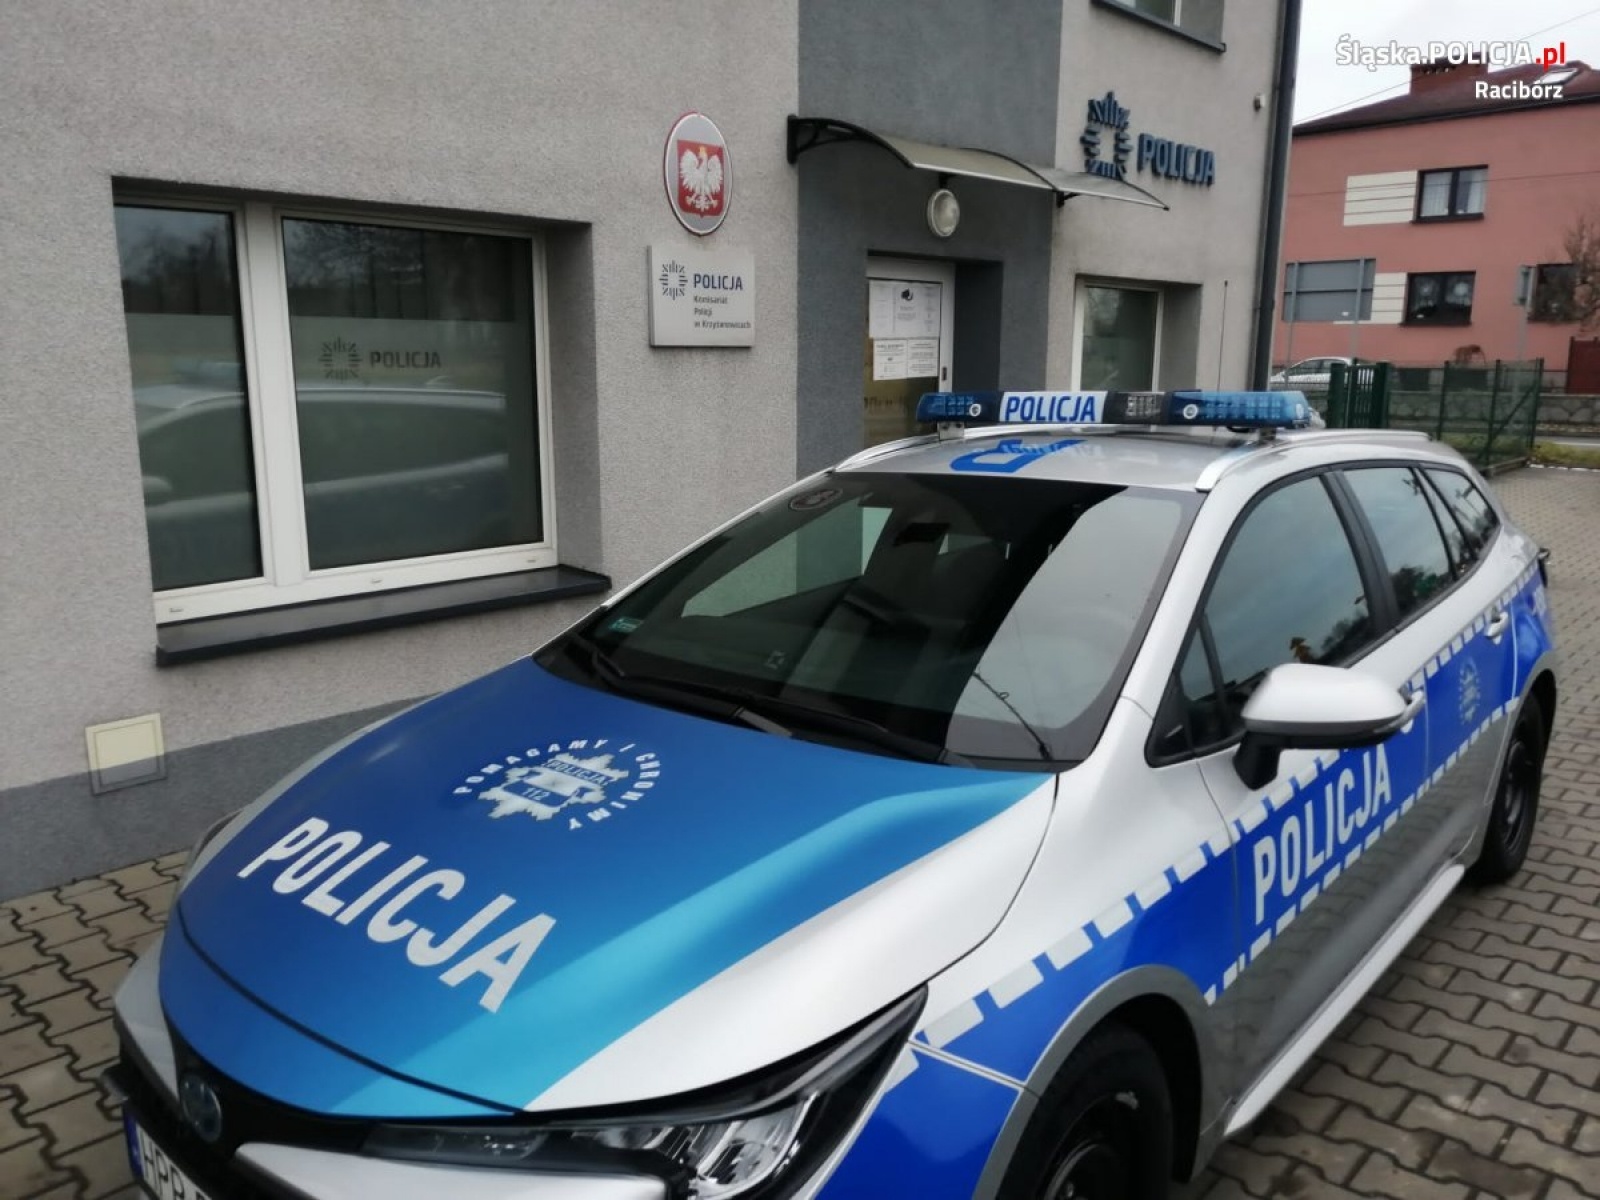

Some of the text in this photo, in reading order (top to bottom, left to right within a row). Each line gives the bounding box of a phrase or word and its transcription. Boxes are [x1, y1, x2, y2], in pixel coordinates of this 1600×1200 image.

[1137, 133, 1215, 186] POLICJA
[693, 274, 743, 290] POLICJA
[369, 351, 442, 369] POLICJA
[1005, 396, 1095, 422] POLICJA
[547, 759, 609, 784] POLICJA
[1253, 743, 1392, 925] POLICJA
[237, 816, 557, 1014] POLICJA
